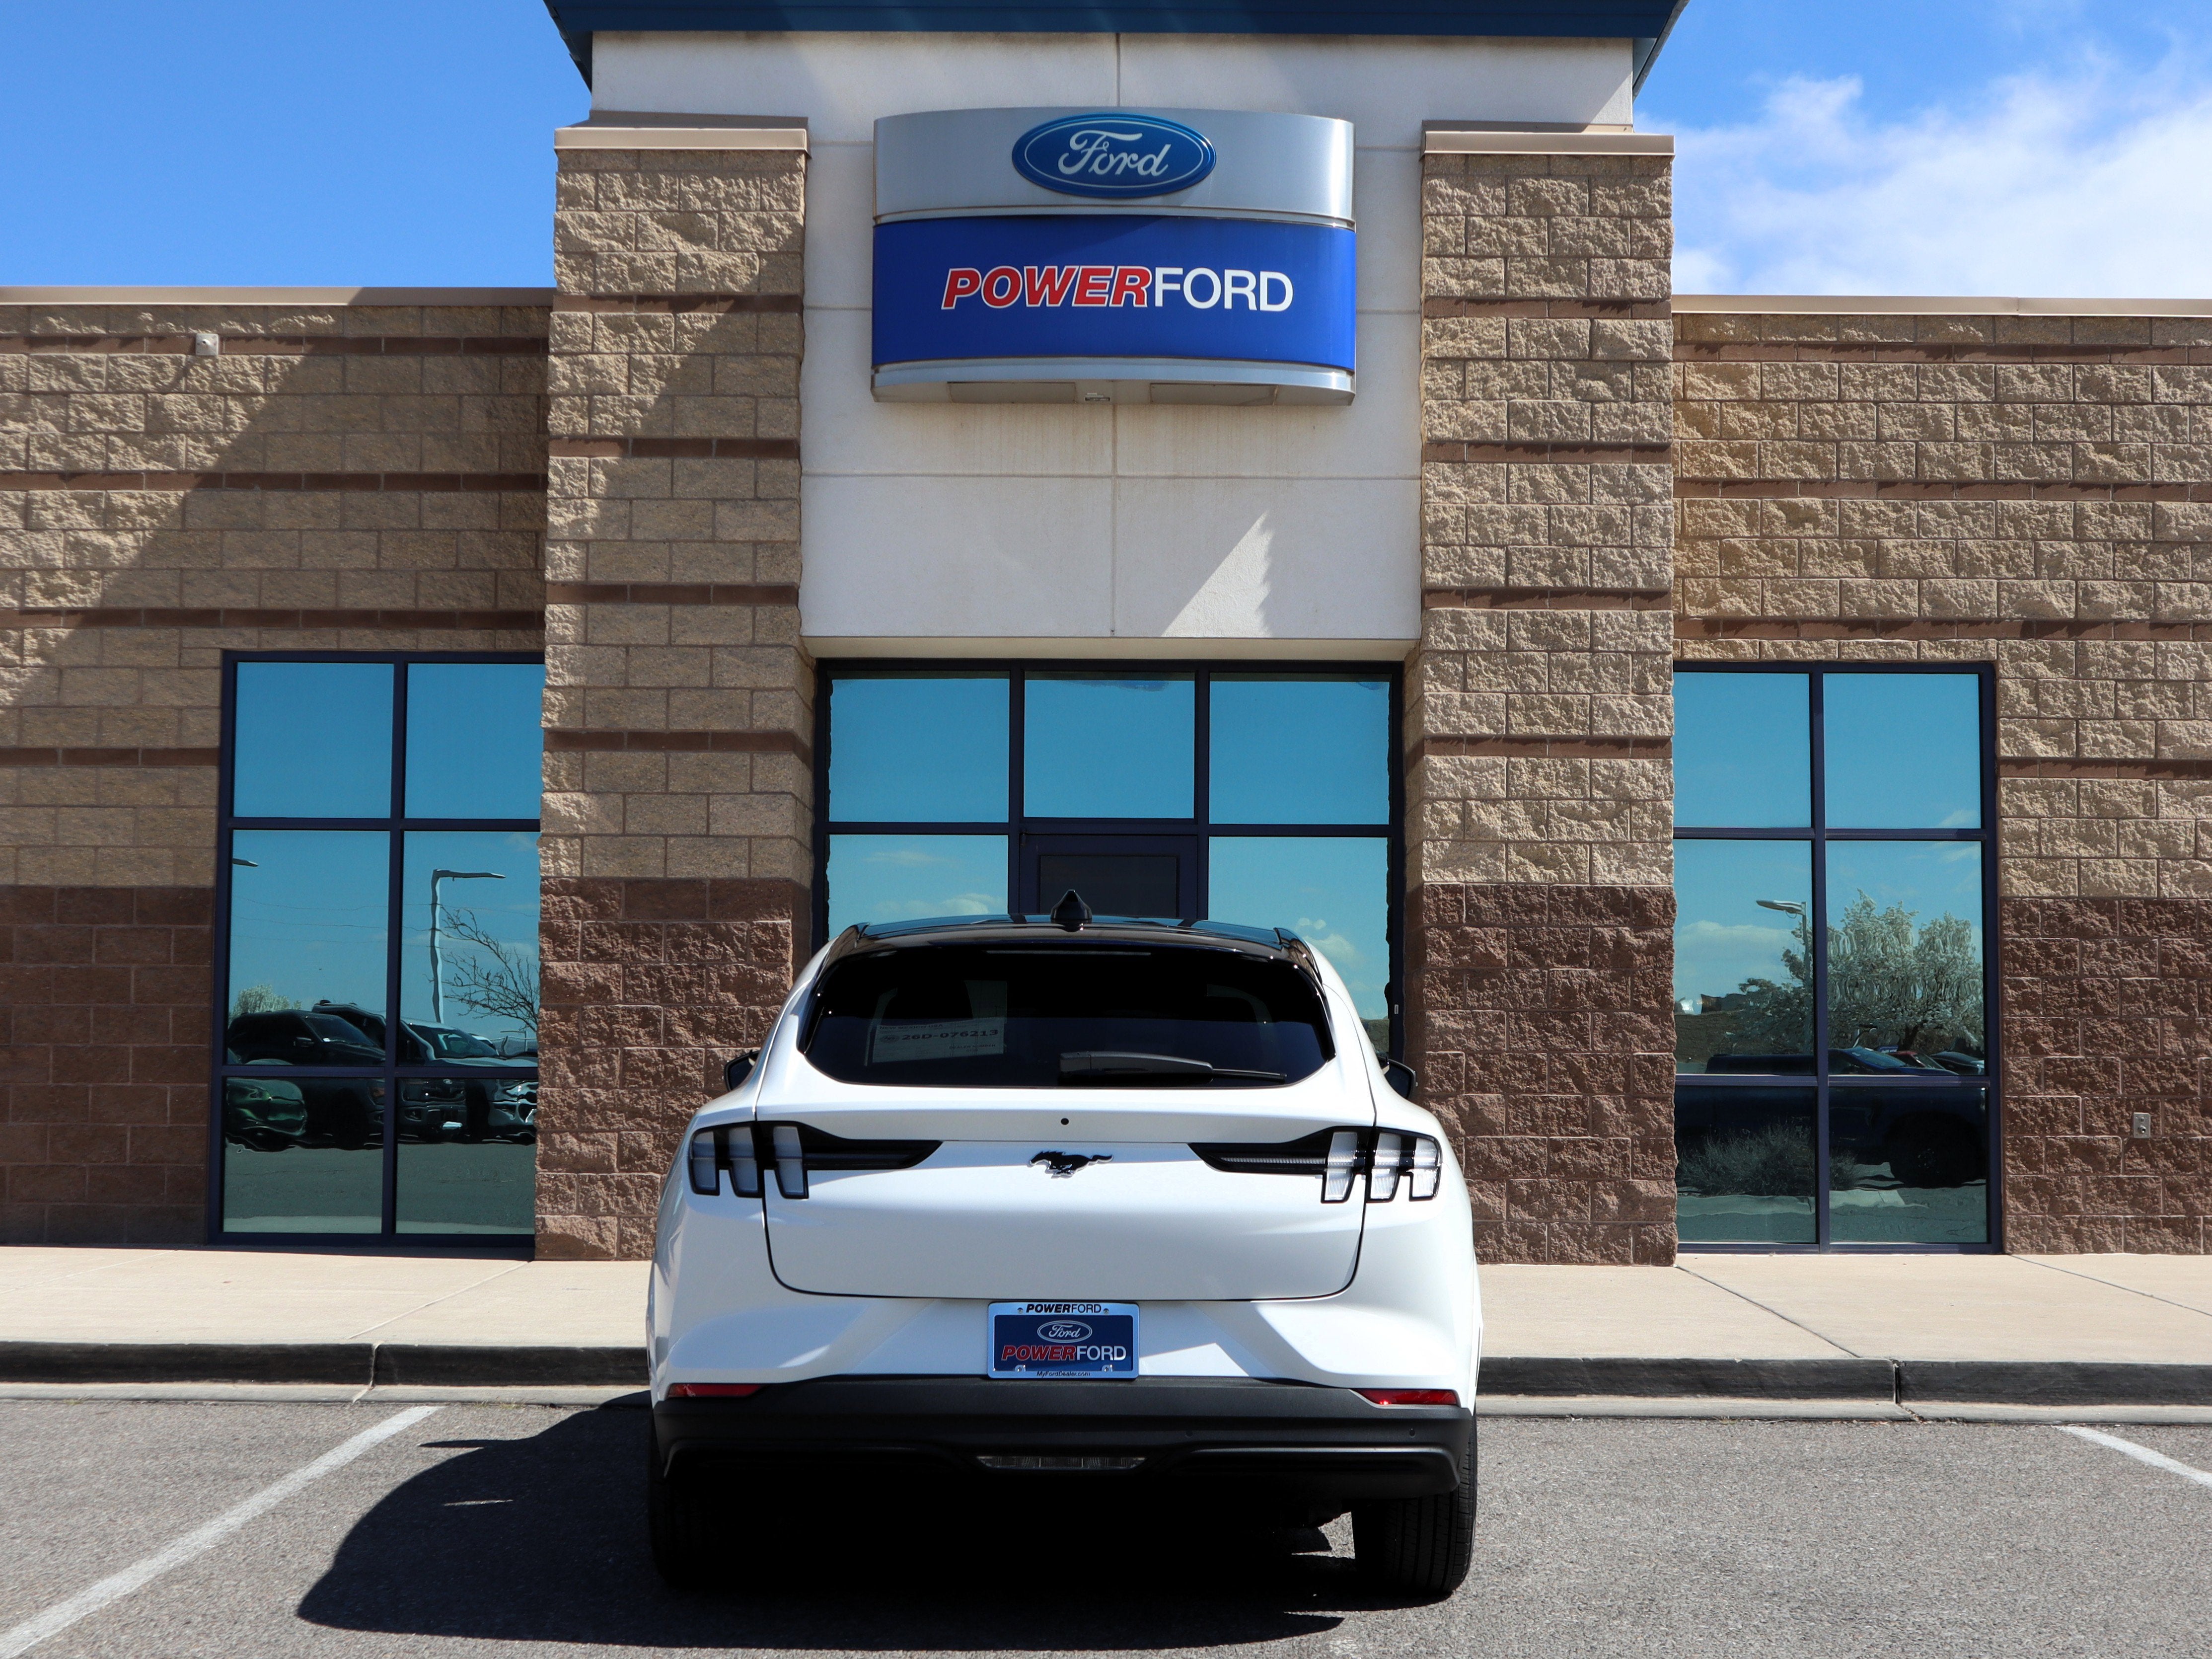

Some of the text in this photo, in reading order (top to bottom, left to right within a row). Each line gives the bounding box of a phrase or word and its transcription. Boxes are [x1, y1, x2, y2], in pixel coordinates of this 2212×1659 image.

[1057, 129, 1172, 177] Ford
[941, 265, 1294, 312] POWERFORD
[902, 1029, 999, 1040] 26D-076213
[1026, 1303, 1102, 1313] POWERFORD
[1048, 1324, 1080, 1338] Ford
[1001, 1345, 1127, 1361] POWERFORD
